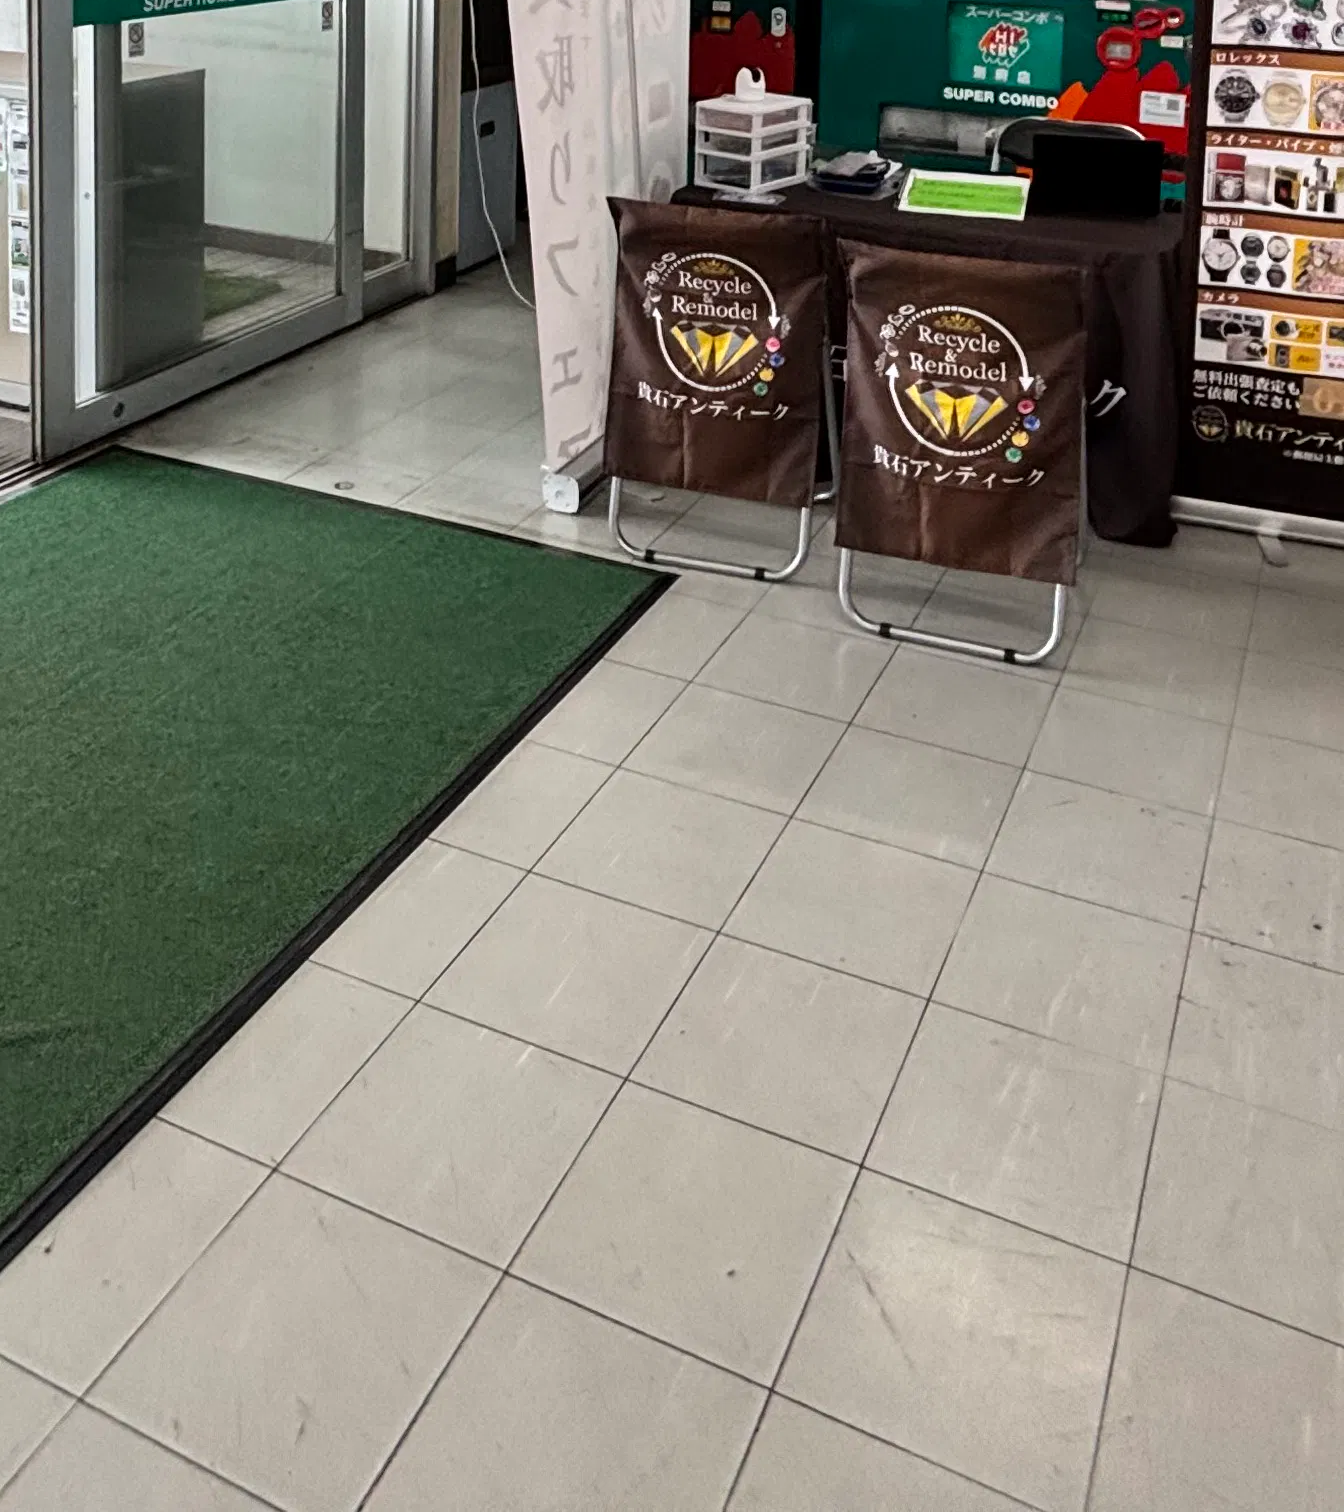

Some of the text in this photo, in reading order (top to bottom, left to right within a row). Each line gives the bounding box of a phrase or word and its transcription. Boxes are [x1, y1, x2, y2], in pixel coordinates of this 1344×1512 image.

[965, 5, 1051, 24] スーパーコンボ
[1216, 52, 1280, 66] ロレックス
[943, 87, 1059, 109] SUPER COMBO
[678, 271, 752, 297] Recycle
[671, 295, 758, 321] Remodel
[1202, 293, 1240, 305] カメラ
[917, 324, 1001, 353] Recycle
[909, 351, 1007, 382] Remodel
[944, 348, 958, 363] &
[637, 381, 789, 421] 貴石アンティーク
[873, 444, 1045, 489] 貴石アンティーク
